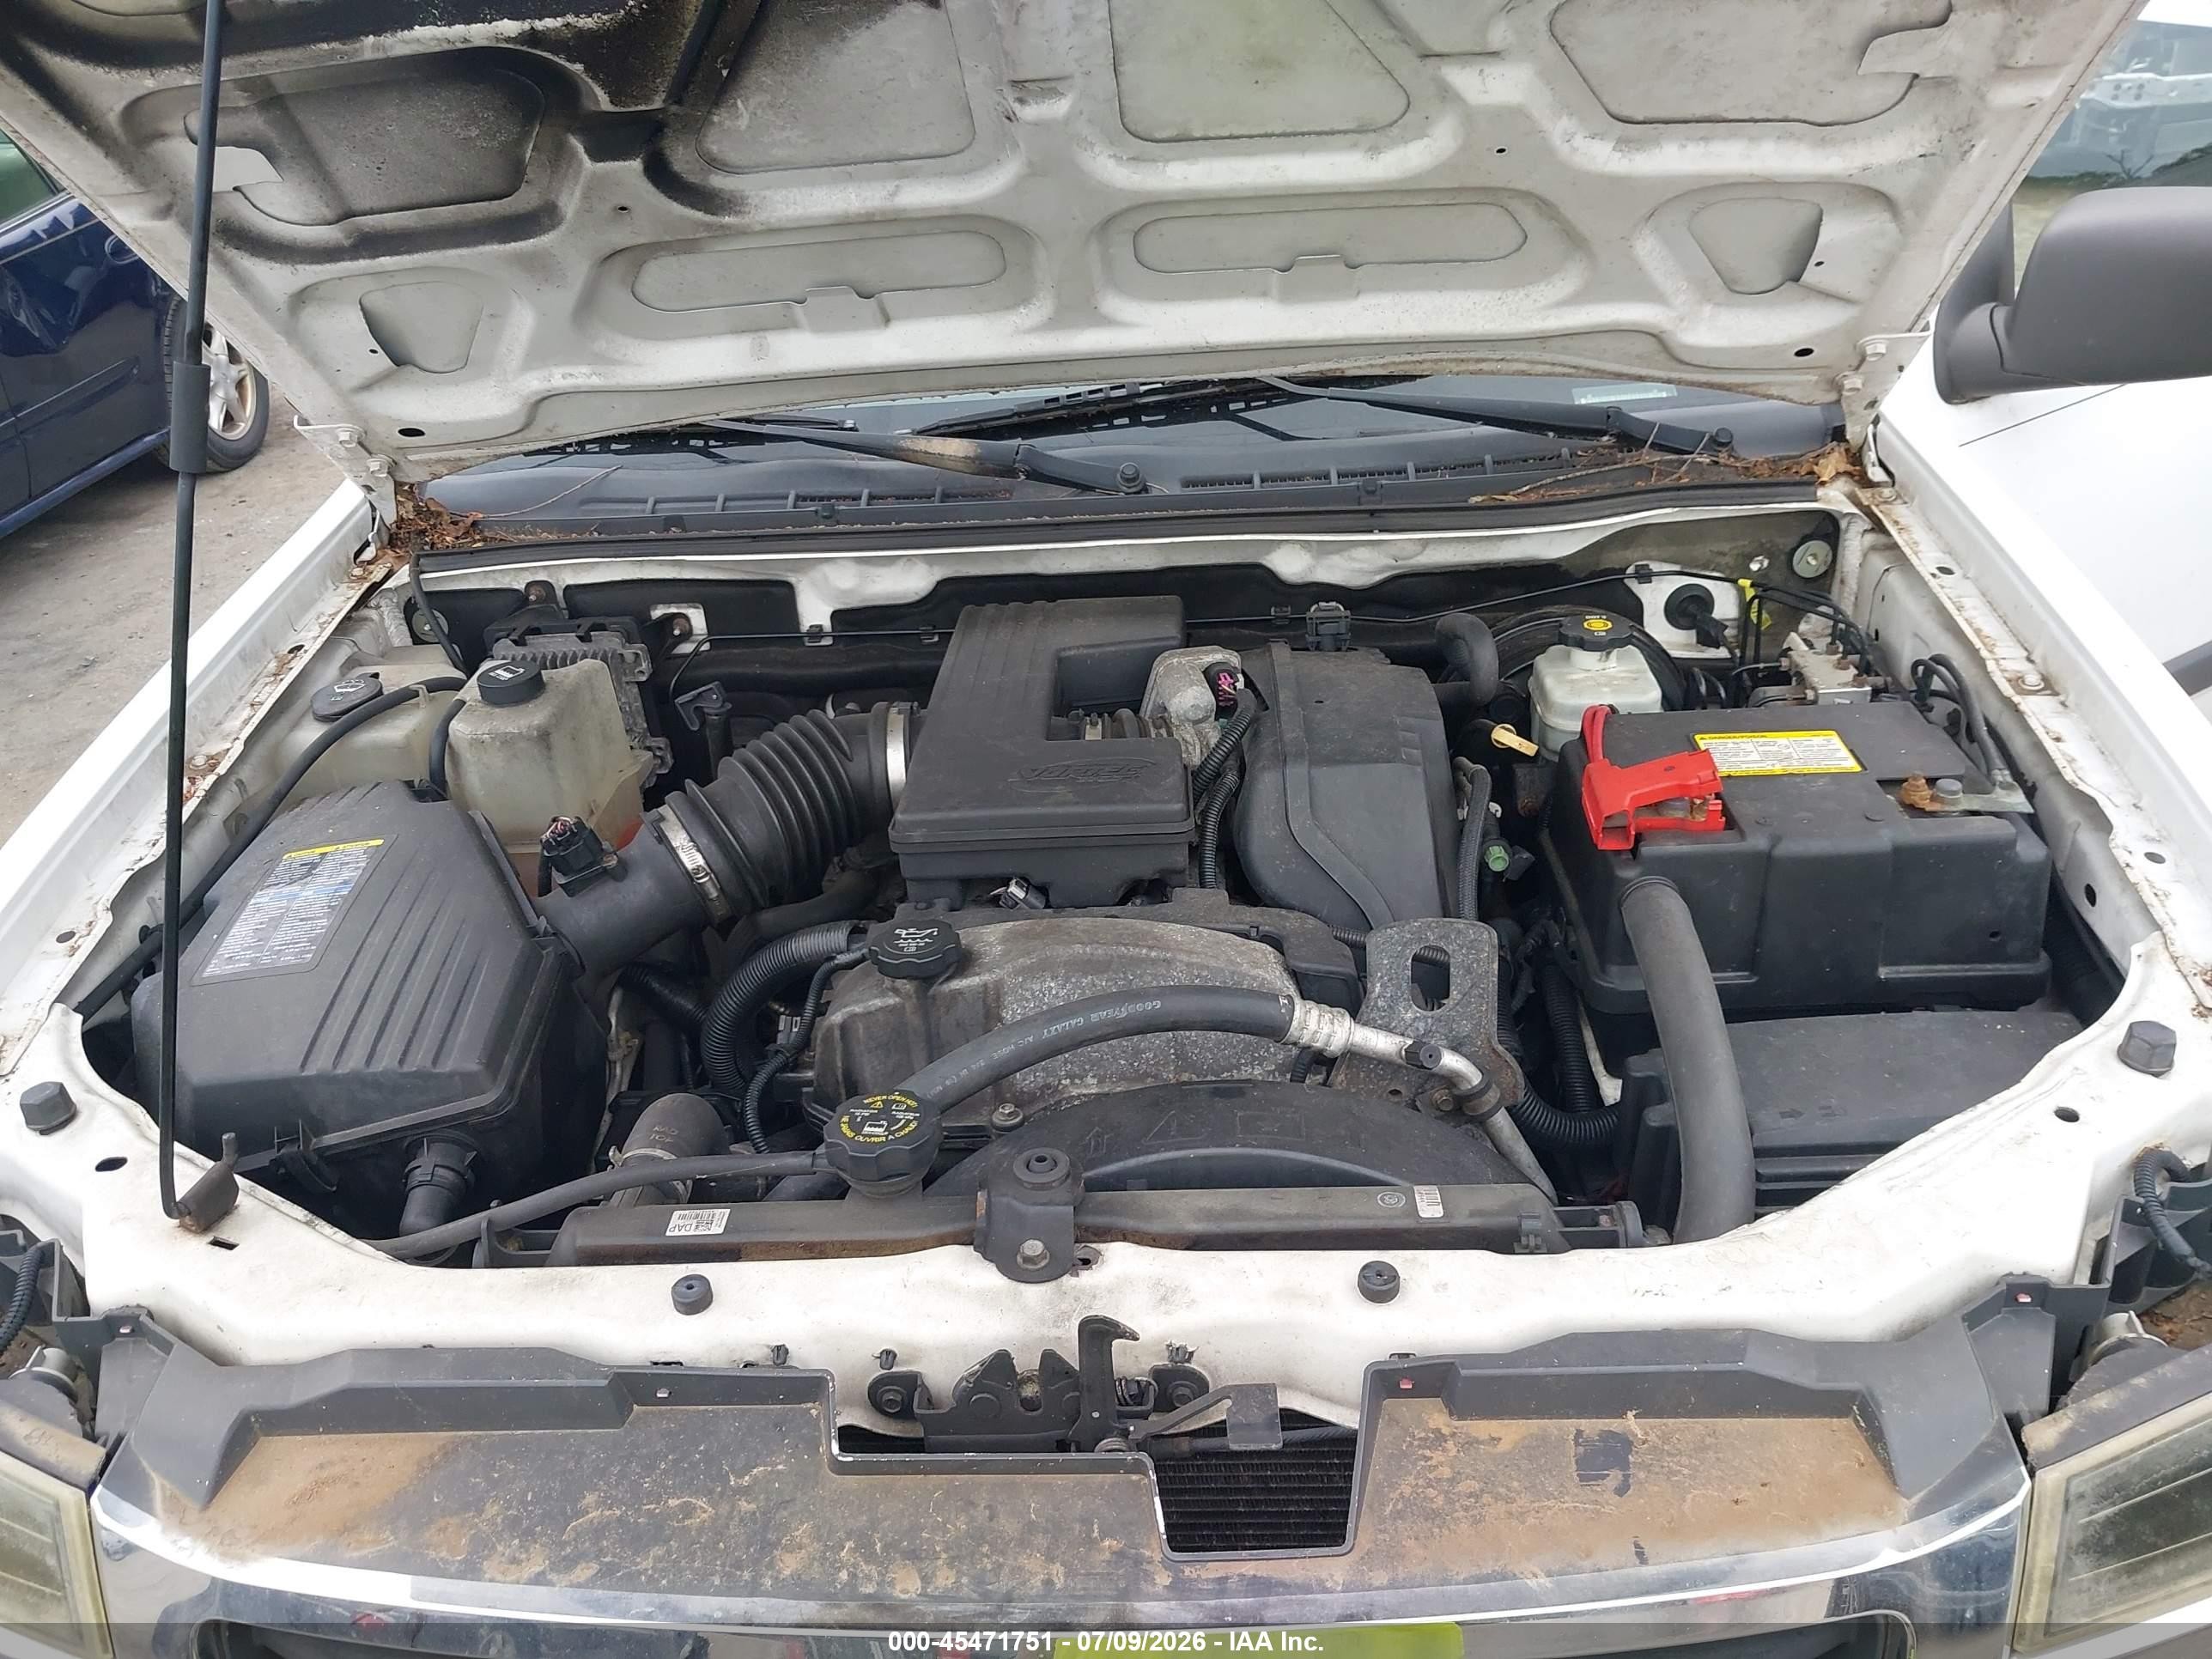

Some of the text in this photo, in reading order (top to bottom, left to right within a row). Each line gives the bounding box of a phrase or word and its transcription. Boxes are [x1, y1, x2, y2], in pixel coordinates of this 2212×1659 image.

[1090, 1000, 1162, 1022] GOODYEAR
[1042, 1017, 1084, 1040] GALAXY
[991, 1039, 1015, 1060] HOSE
[863, 1095, 887, 1103] NEVER
[854, 1134, 887, 1143] OUVRIR
[669, 1223, 693, 1232] DAP
